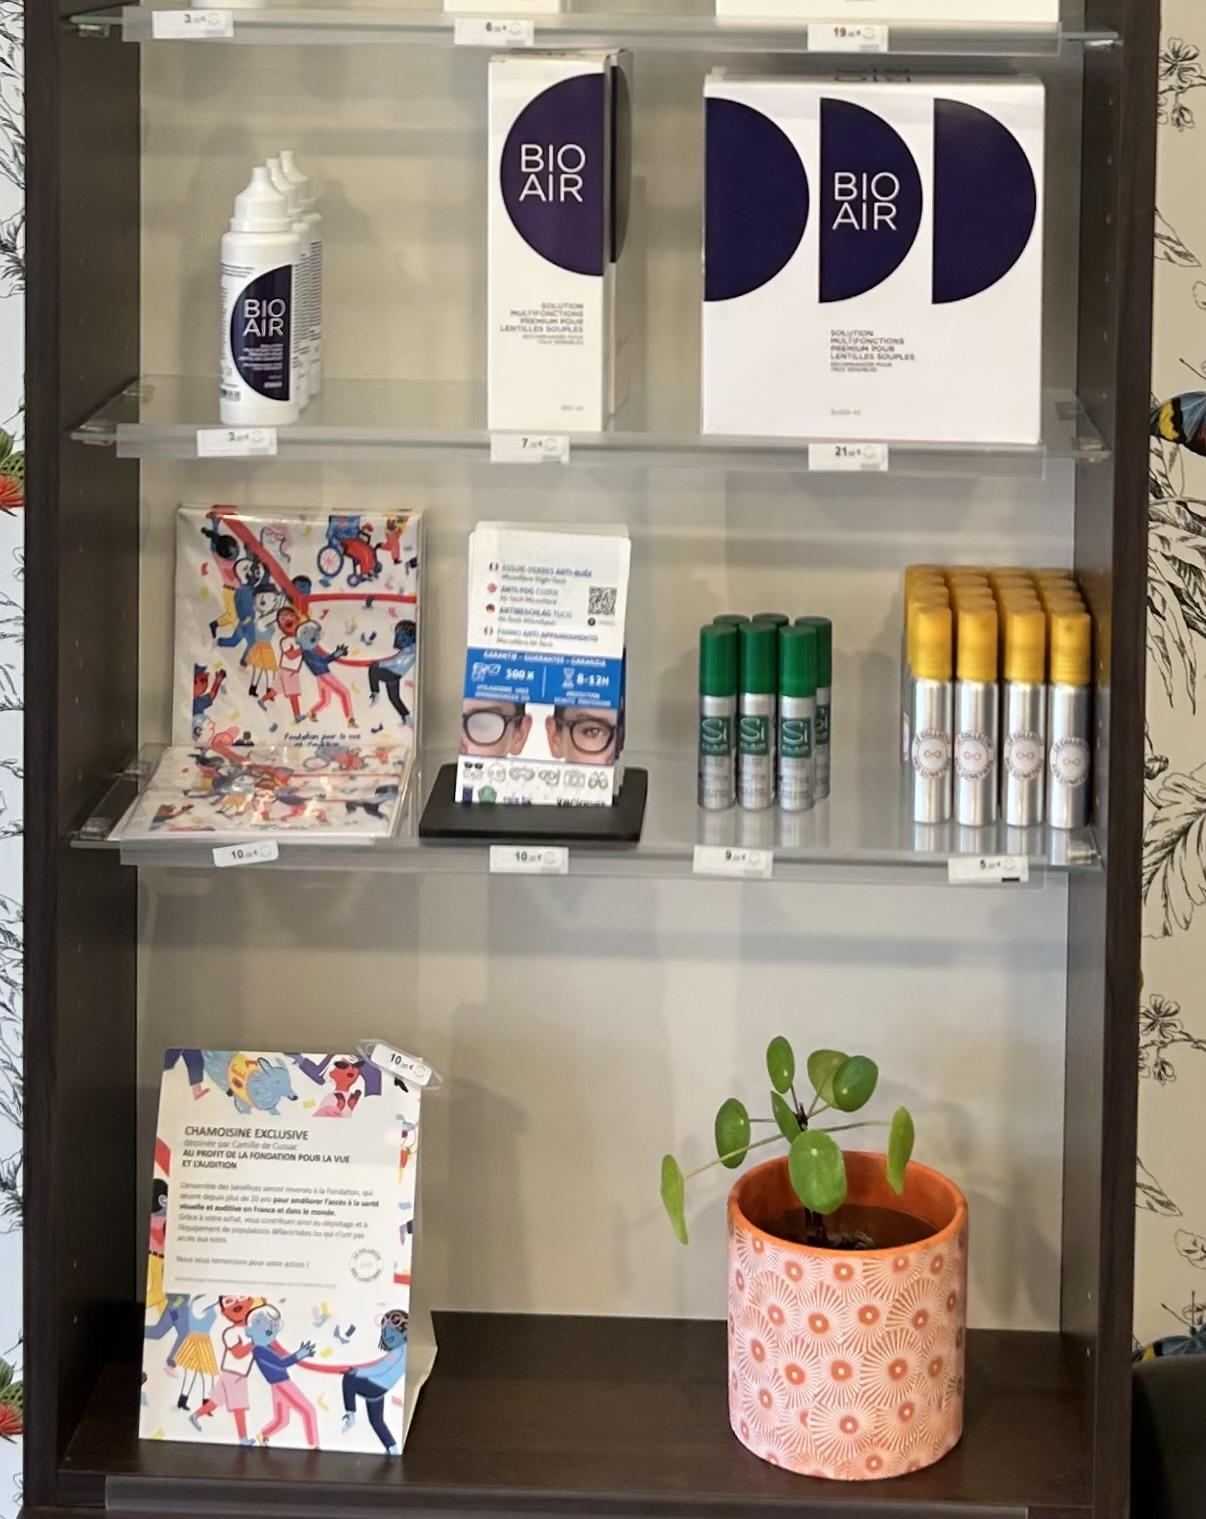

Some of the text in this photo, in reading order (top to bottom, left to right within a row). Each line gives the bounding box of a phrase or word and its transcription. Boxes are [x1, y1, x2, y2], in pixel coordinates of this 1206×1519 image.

[521, 144, 586, 173] BIO
[519, 174, 583, 202] AIR
[834, 172, 899, 202] BIO
[832, 201, 897, 230] AIR
[244, 299, 286, 318] BIO
[541, 302, 583, 310] SOLUTION
[243, 318, 284, 337] AIR
[830, 337, 904, 345] MULTIFONCTIONS
[877, 353, 915, 361] SOUPLES
[702, 718, 727, 741] Si
[740, 717, 765, 741] Si
[783, 720, 808, 743] Si
[185, 1125, 309, 1140] CHAMOISINE EXCLUSIVE
[184, 1139, 216, 1148] dessinée
[217, 1141, 231, 1149] par
[182, 1160, 237, 1169] ET L'AUDITION
[183, 1149, 194, 1157] AU
[197, 1150, 224, 1158] PROFIT
[250, 1152, 296, 1161] FONDATION
[298, 1154, 320, 1162] POUR
[334, 1155, 350, 1163] VUE
